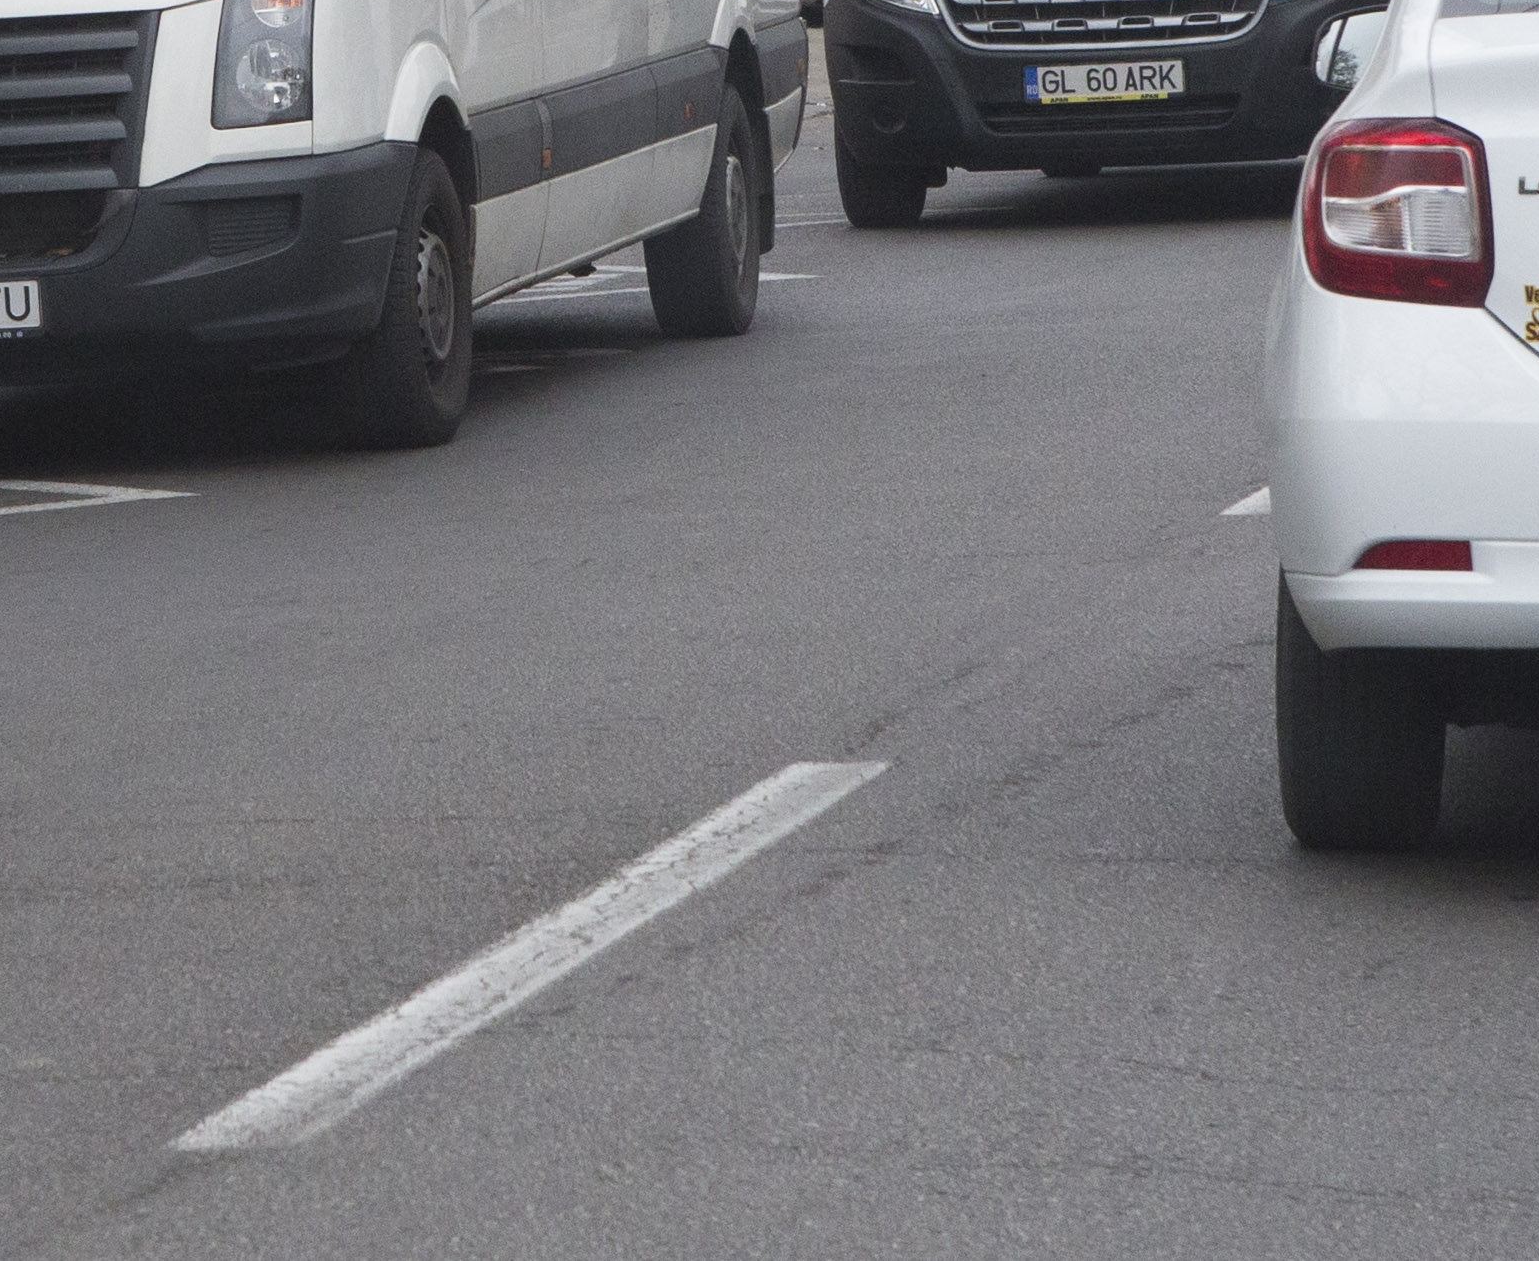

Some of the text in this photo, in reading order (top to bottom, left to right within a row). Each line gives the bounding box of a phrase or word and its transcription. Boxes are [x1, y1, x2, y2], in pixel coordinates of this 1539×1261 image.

[1042, 69, 1076, 94] GL
[1086, 67, 1118, 92] 60
[1125, 63, 1177, 92] ARK
